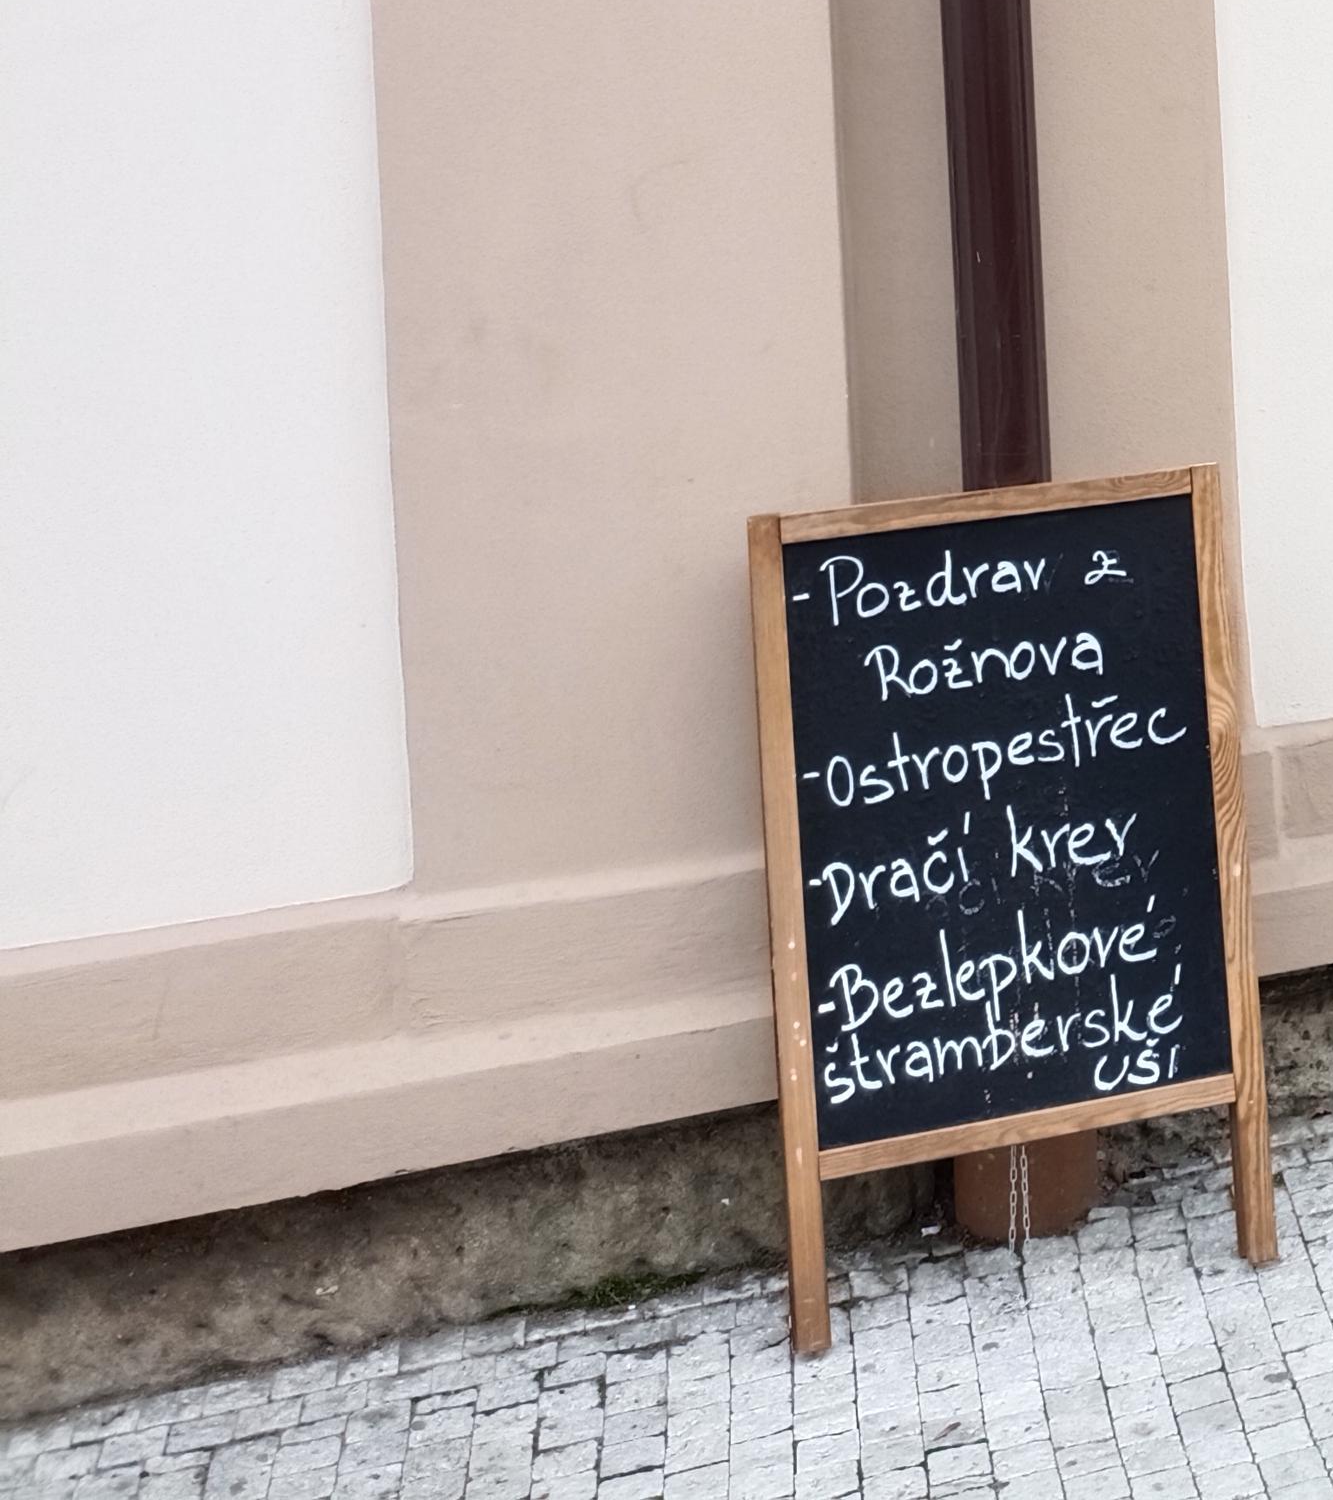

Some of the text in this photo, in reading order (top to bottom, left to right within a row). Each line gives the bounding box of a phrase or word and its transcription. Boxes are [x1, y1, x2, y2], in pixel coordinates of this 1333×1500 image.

[864, 632, 1103, 701] Rožnova
[1006, 805, 1137, 878] krev
[824, 963, 1183, 1104] štramberské
